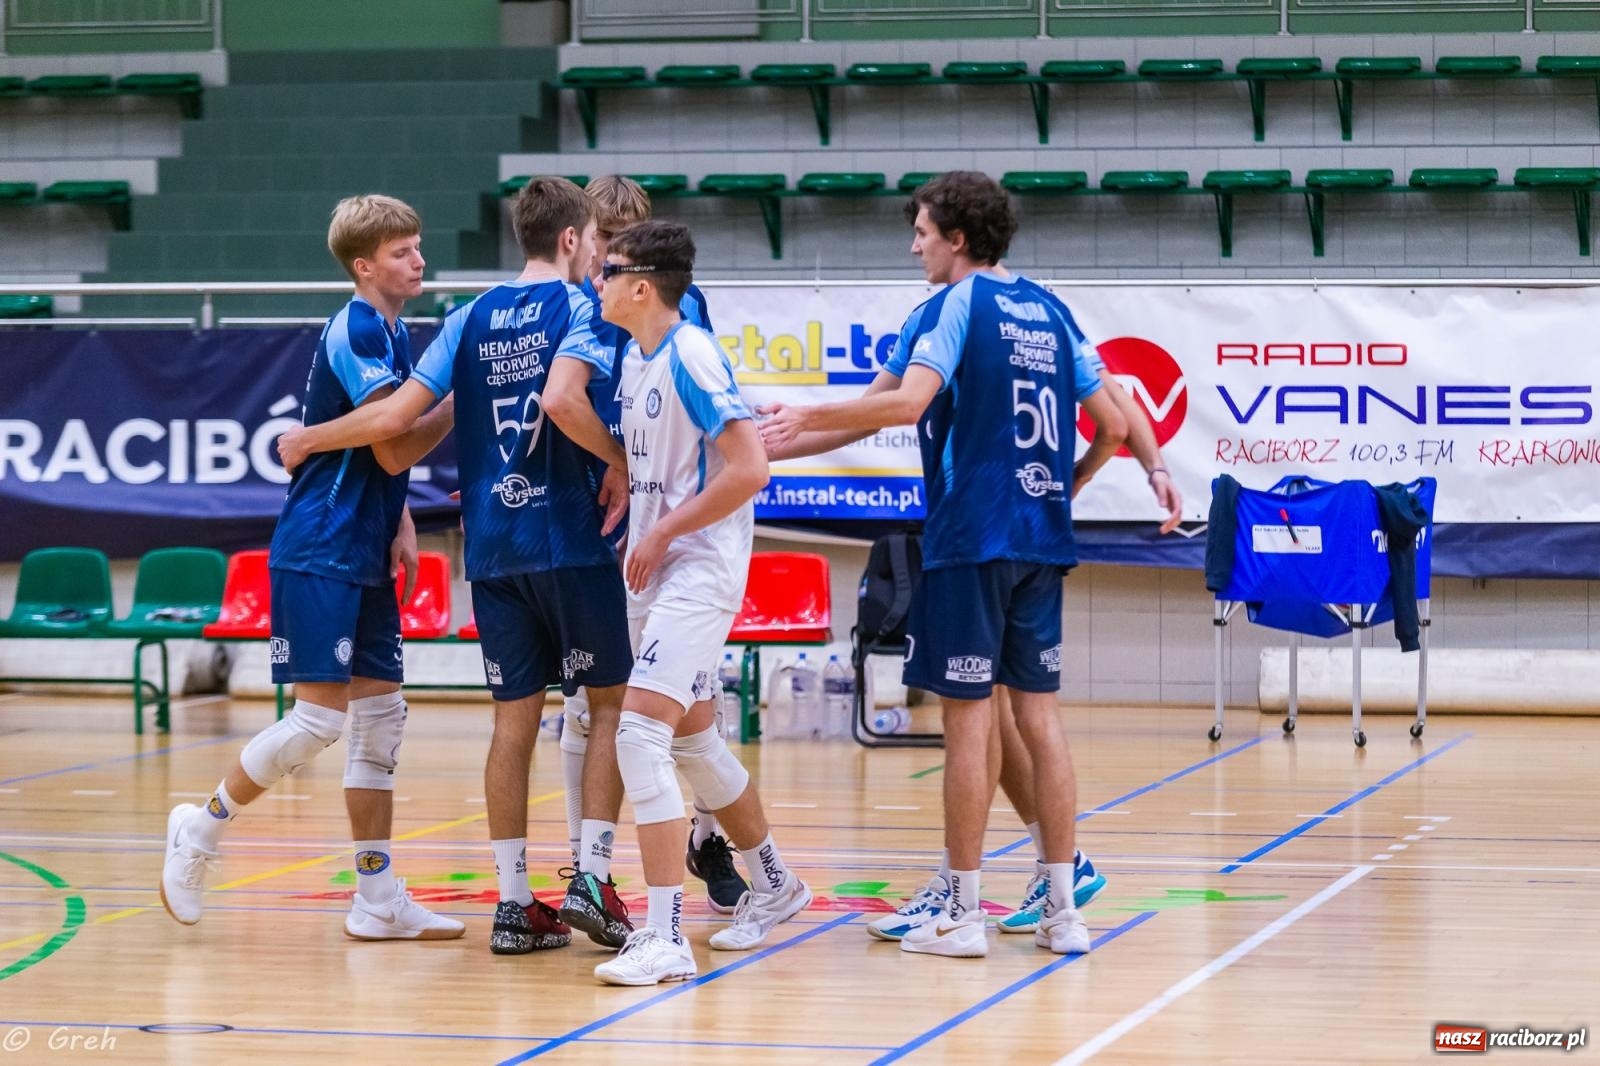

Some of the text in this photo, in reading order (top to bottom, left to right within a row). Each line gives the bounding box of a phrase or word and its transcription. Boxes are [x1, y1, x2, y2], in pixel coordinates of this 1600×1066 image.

[490, 302, 543, 330] MACIEJ
[479, 331, 549, 359] HEMARPOL
[718, 320, 900, 372] stal-te
[1217, 342, 1408, 366] RADIO
[492, 352, 540, 374] NORWID
[492, 391, 545, 464] 59
[1012, 379, 1059, 452] 50
[1349, 443, 1407, 466] 100,3
[1414, 439, 1453, 466] FM
[754, 484, 922, 512] w.instal-tech.pl
[947, 657, 993, 673] WŁODAR
[758, 843, 783, 889] NORWID
[671, 891, 683, 946] NORWID
